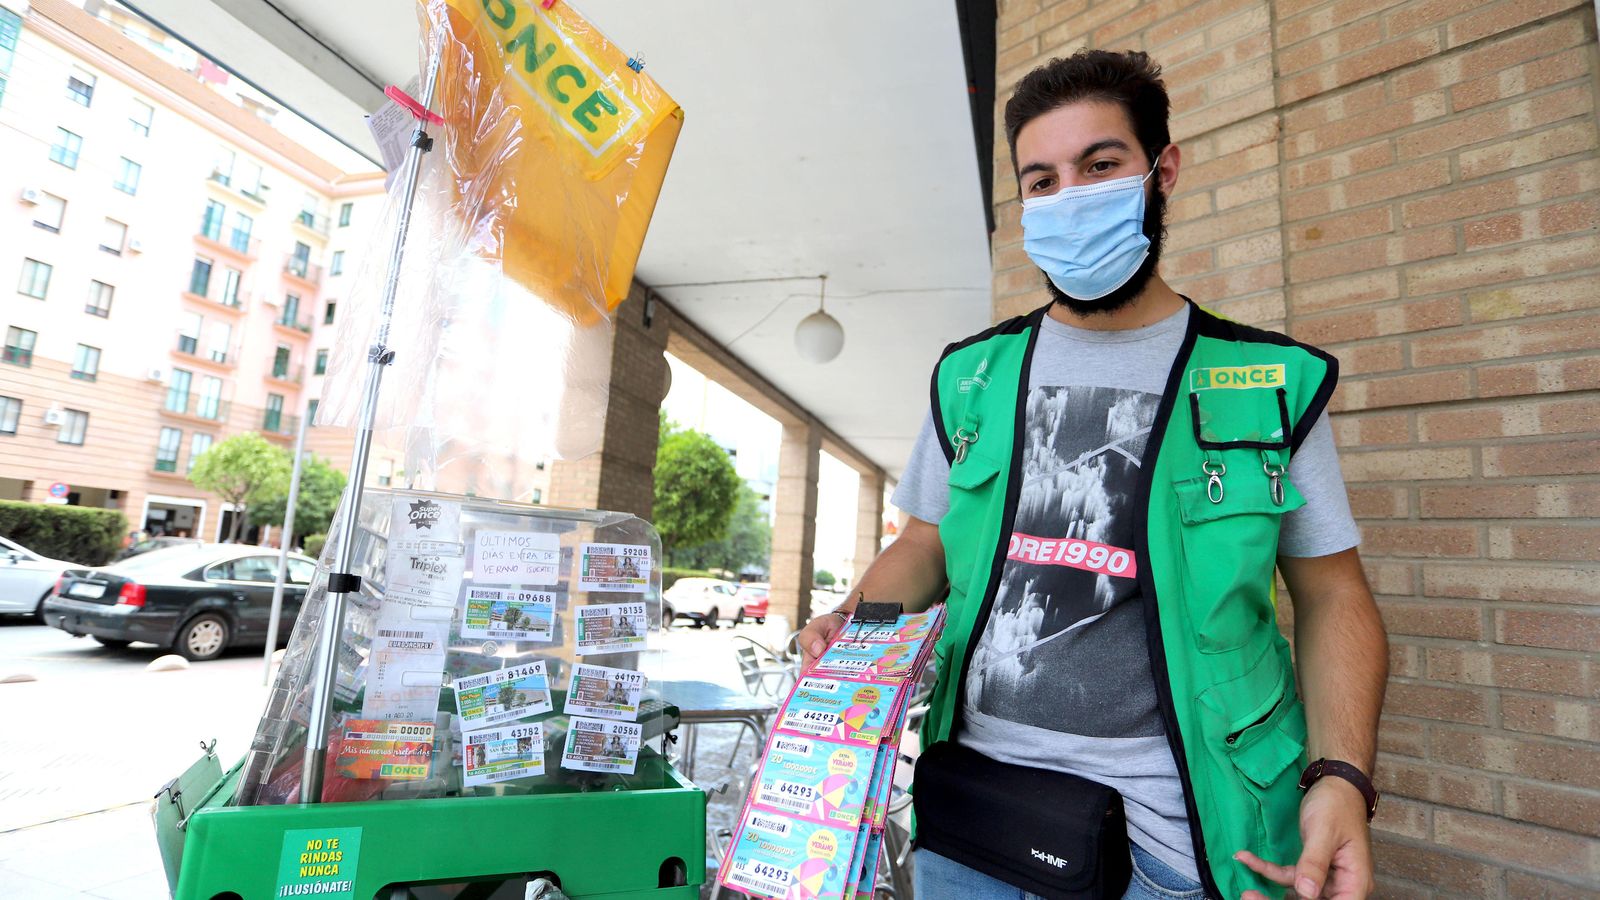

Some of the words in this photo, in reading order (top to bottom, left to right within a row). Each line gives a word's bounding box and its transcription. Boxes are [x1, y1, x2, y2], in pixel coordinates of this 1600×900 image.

[482, 0, 618, 133] ONCE
[1215, 368, 1277, 385] ONCE
[544, 552, 553, 560] DE
[623, 548, 648, 556] 59208
[483, 565, 519, 575] VERANO
[519, 594, 551, 603] 09688
[619, 607, 643, 615] 78135
[388, 640, 434, 650] EUROJACKPOT
[508, 665, 541, 679] 81469
[615, 673, 641, 683] 64197
[804, 711, 835, 723] 64293
[400, 726, 432, 736] 00000
[511, 727, 539, 738] 43782
[613, 726, 639, 736] 20586
[341, 746, 358, 755] Mis
[394, 767, 425, 776] ONCE
[780, 782, 812, 798] 64293
[306, 840, 323, 851] NO
[327, 839, 340, 850] TE
[812, 840, 834, 852] VERANO
[300, 851, 343, 864] RINDAS
[300, 864, 339, 878] NUNCA
[755, 863, 789, 882] 64293
[279, 880, 353, 898] ¡ILUSIÓNATE!
